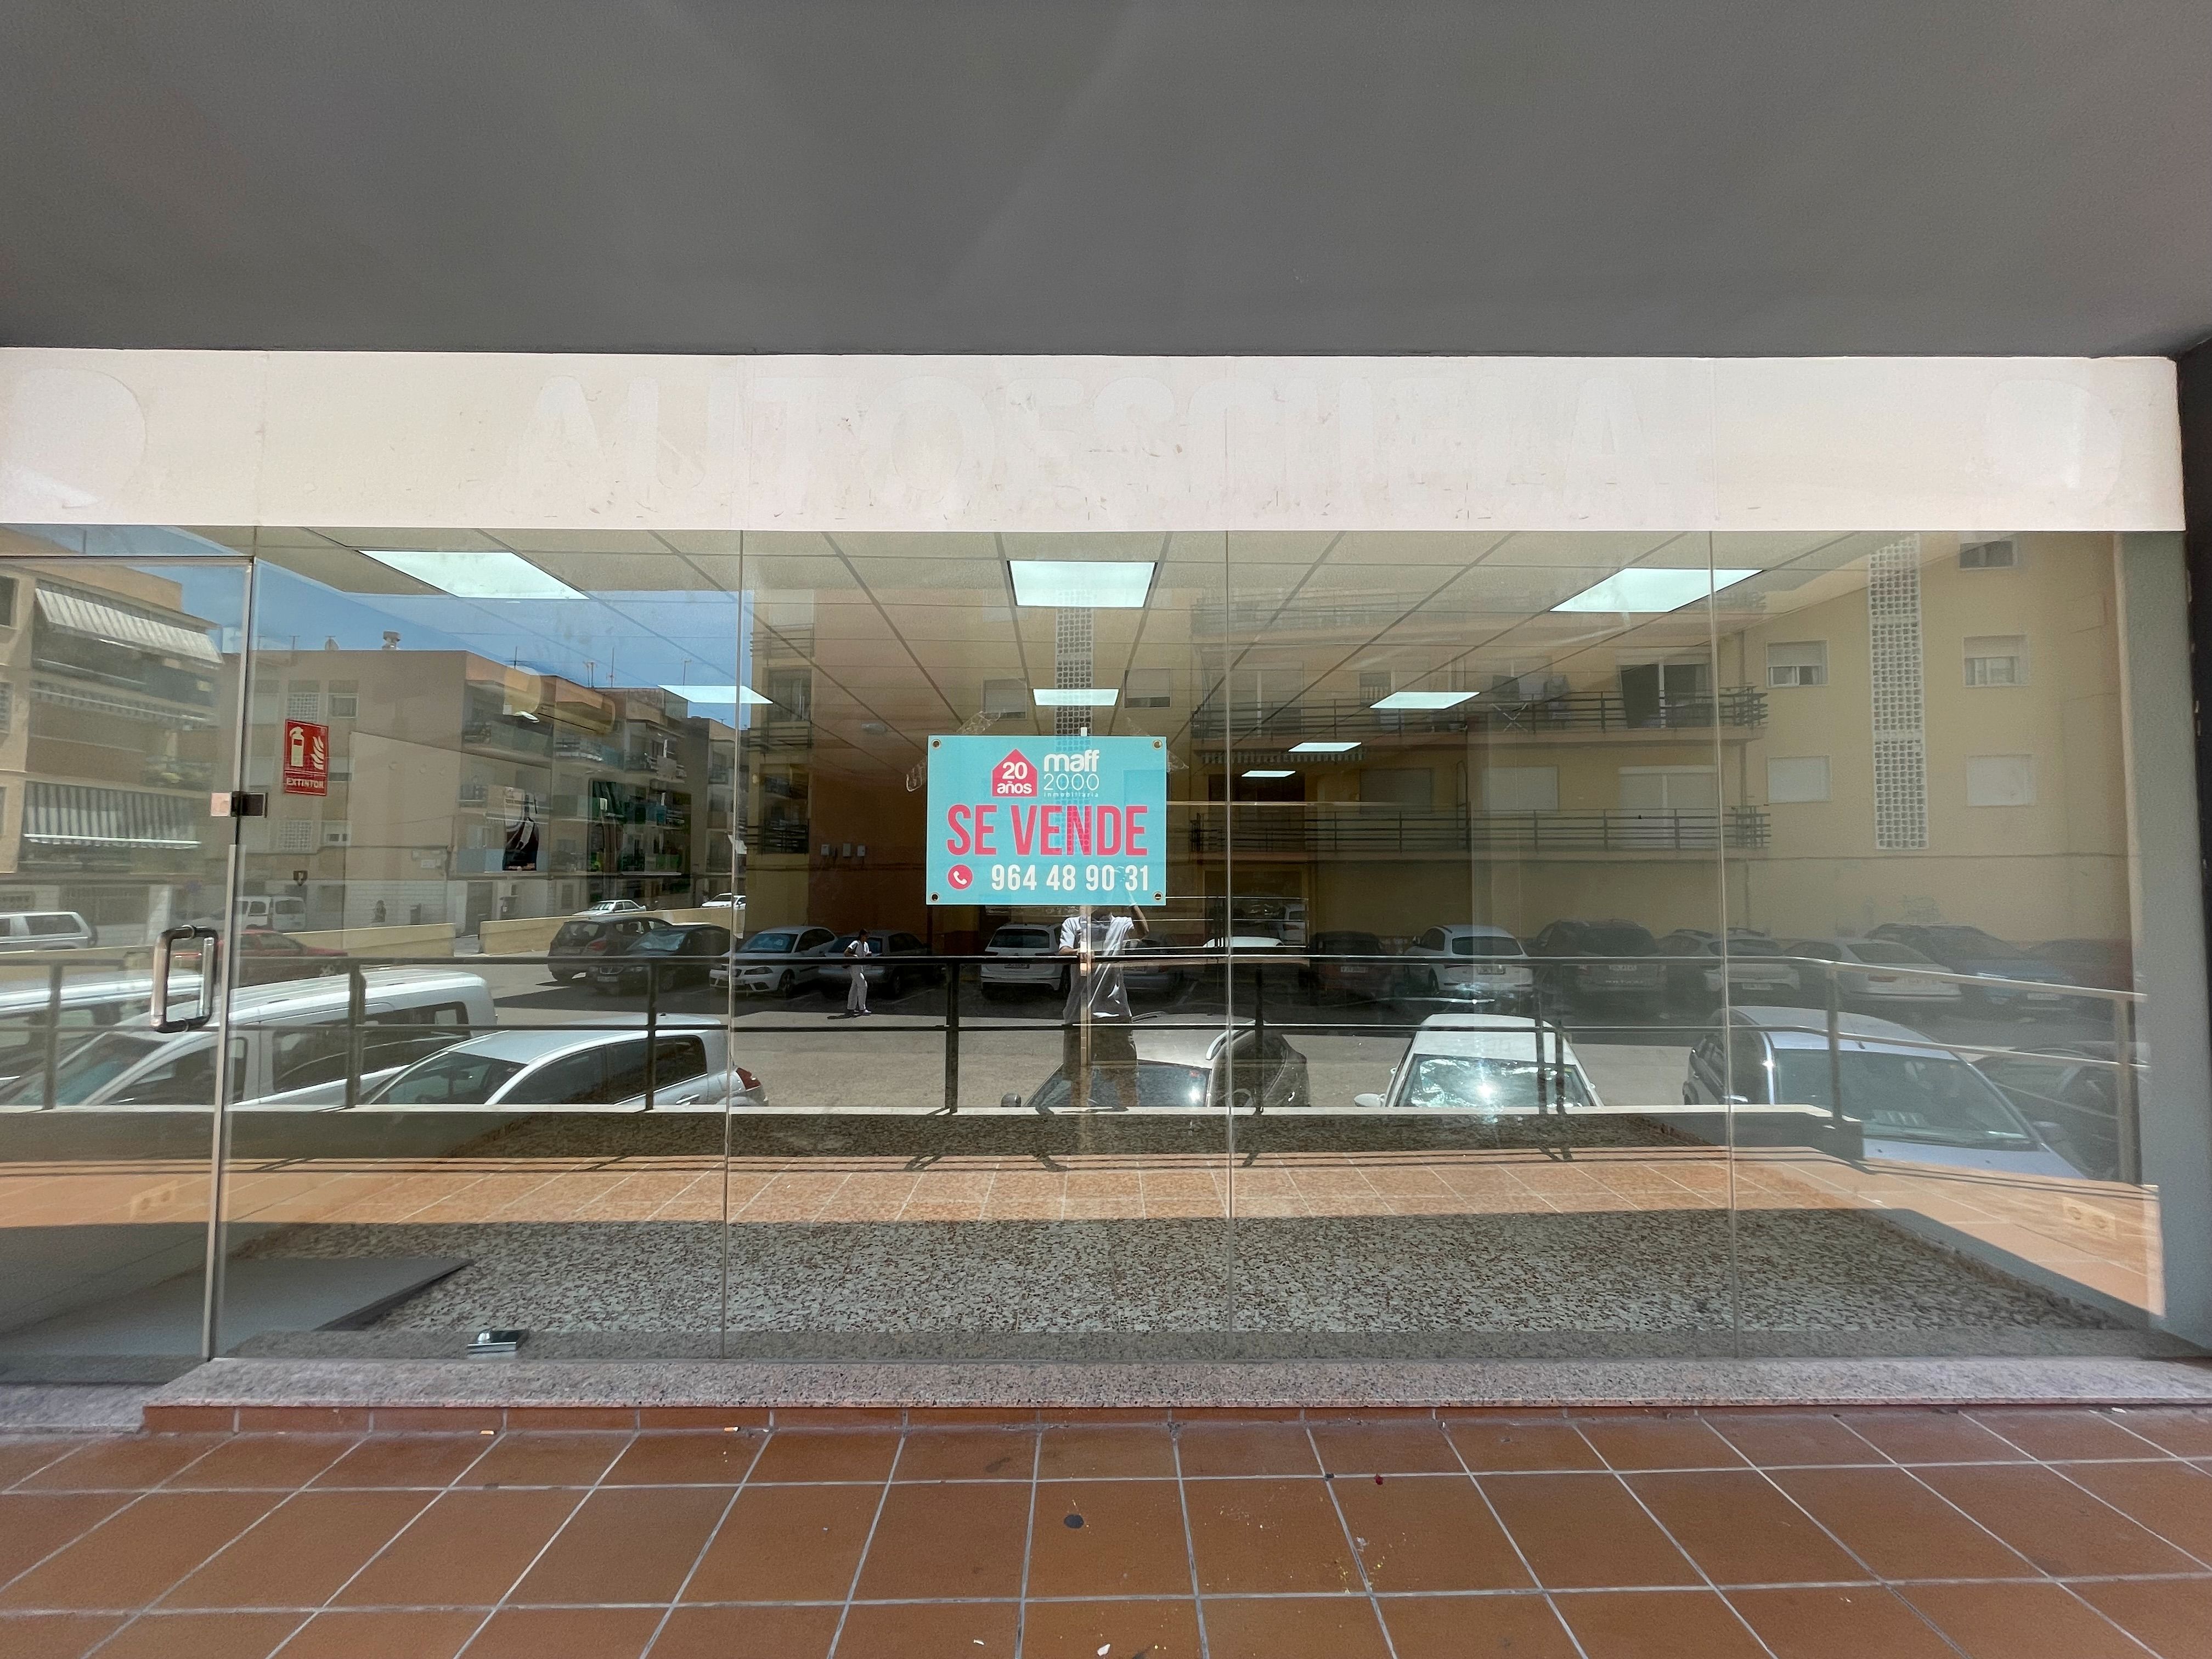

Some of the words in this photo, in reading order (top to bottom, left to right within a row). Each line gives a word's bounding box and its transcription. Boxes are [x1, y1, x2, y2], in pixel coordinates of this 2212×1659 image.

[1043, 749, 1101, 772] maff
[1002, 761, 1028, 780] 20
[286, 777, 324, 788] EXTINTOR
[996, 781, 1032, 794] años
[1043, 773, 1100, 791] 2000
[947, 804, 997, 856] SE
[1010, 804, 1148, 856] VENDE
[991, 864, 1037, 891] 964
[1046, 864, 1076, 891] 48
[1085, 865, 1115, 891] 90
[1125, 865, 1148, 891] 31
